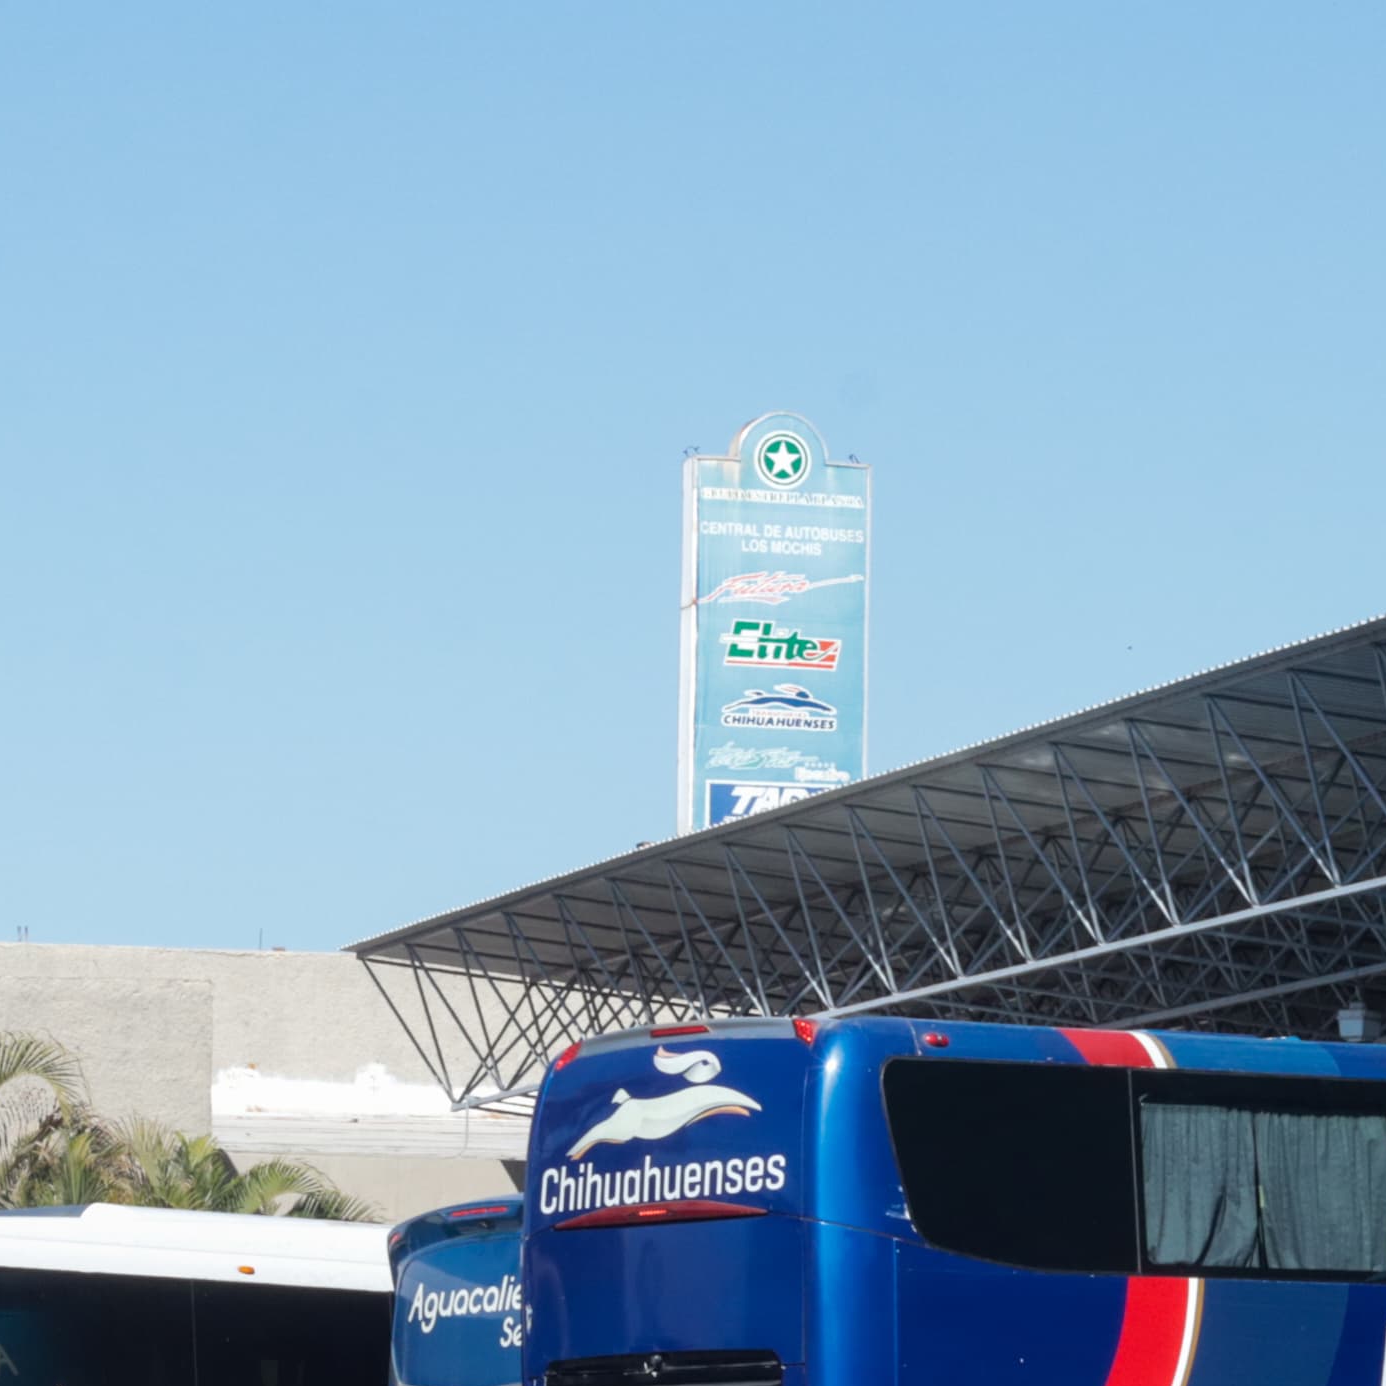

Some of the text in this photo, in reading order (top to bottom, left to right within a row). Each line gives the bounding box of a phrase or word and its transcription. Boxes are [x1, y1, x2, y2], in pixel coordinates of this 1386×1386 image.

[701, 522, 864, 543] CENTRAL DE AUTOBUSES
[741, 540, 822, 555] LOS MOCHIS
[727, 620, 821, 662] Elite
[724, 715, 834, 729] CHIHUAHUENSES
[540, 1153, 787, 1215] Chihuahuenses
